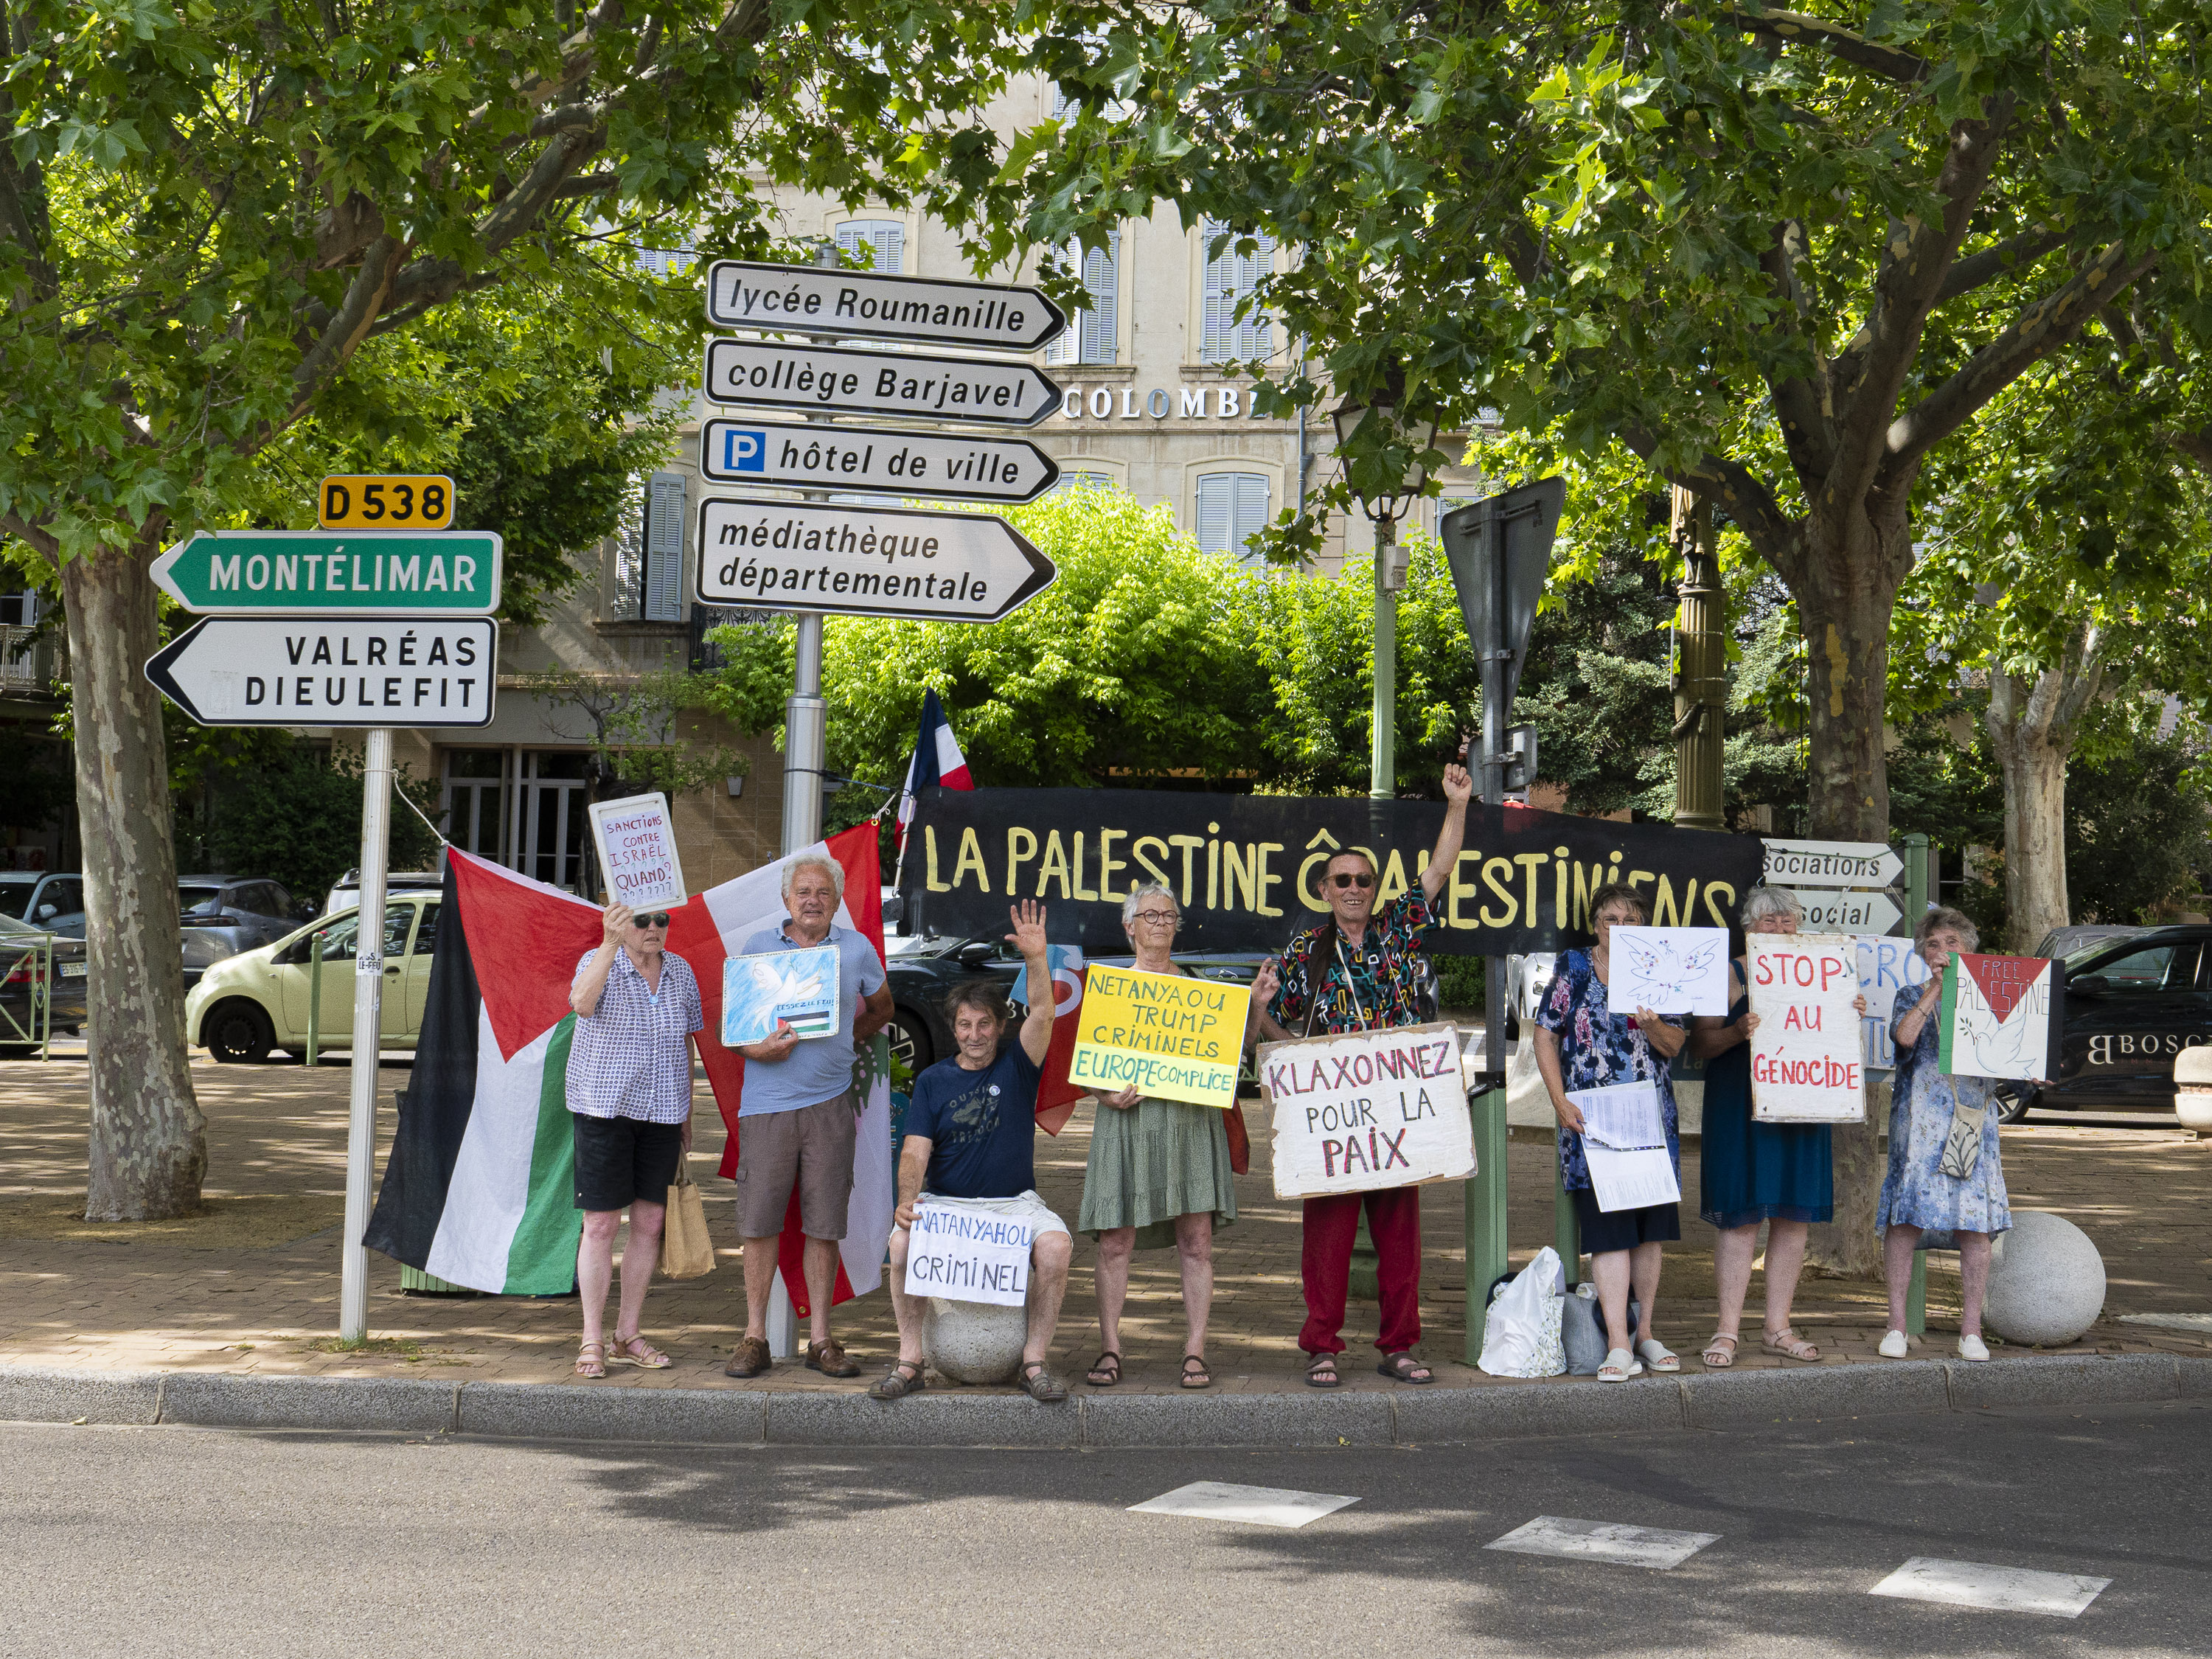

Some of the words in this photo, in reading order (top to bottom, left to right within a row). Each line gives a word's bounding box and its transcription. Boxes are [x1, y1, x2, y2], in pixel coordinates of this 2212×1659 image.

[730, 279, 821, 316] lycée
[835, 288, 1025, 332] Roumanille
[728, 360, 859, 401] collège
[875, 368, 1025, 408] Barjavel
[731, 434, 758, 467] P
[780, 439, 873, 474] hôtel
[888, 448, 927, 478] de
[947, 451, 1019, 484] ville
[325, 484, 350, 521] D
[362, 484, 445, 521] 538
[719, 518, 939, 563] médiathèque
[209, 546, 476, 591] MONTÉLIMAR
[719, 557, 987, 602] départementale
[285, 630, 476, 667] VALRÉAS
[246, 676, 476, 707] DIEULEFIT
[610, 844, 667, 867] ISRAËL
[623, 832, 660, 848] CONTRE
[925, 824, 990, 894] LA
[1756, 953, 1843, 992] STOP
[1981, 960, 2022, 979] FREE
[1088, 974, 1226, 1012] NETANYAOU
[1132, 1004, 1217, 1033] TRUMP
[1784, 1005, 1822, 1032] AU
[1075, 1049, 1160, 1088] EUROPE
[1269, 1040, 1455, 1099] KLAXONNEZ
[1307, 1097, 1378, 1133] POUR
[1399, 1087, 1436, 1122] LA
[916, 1210, 1032, 1250] NATANYAHOU
